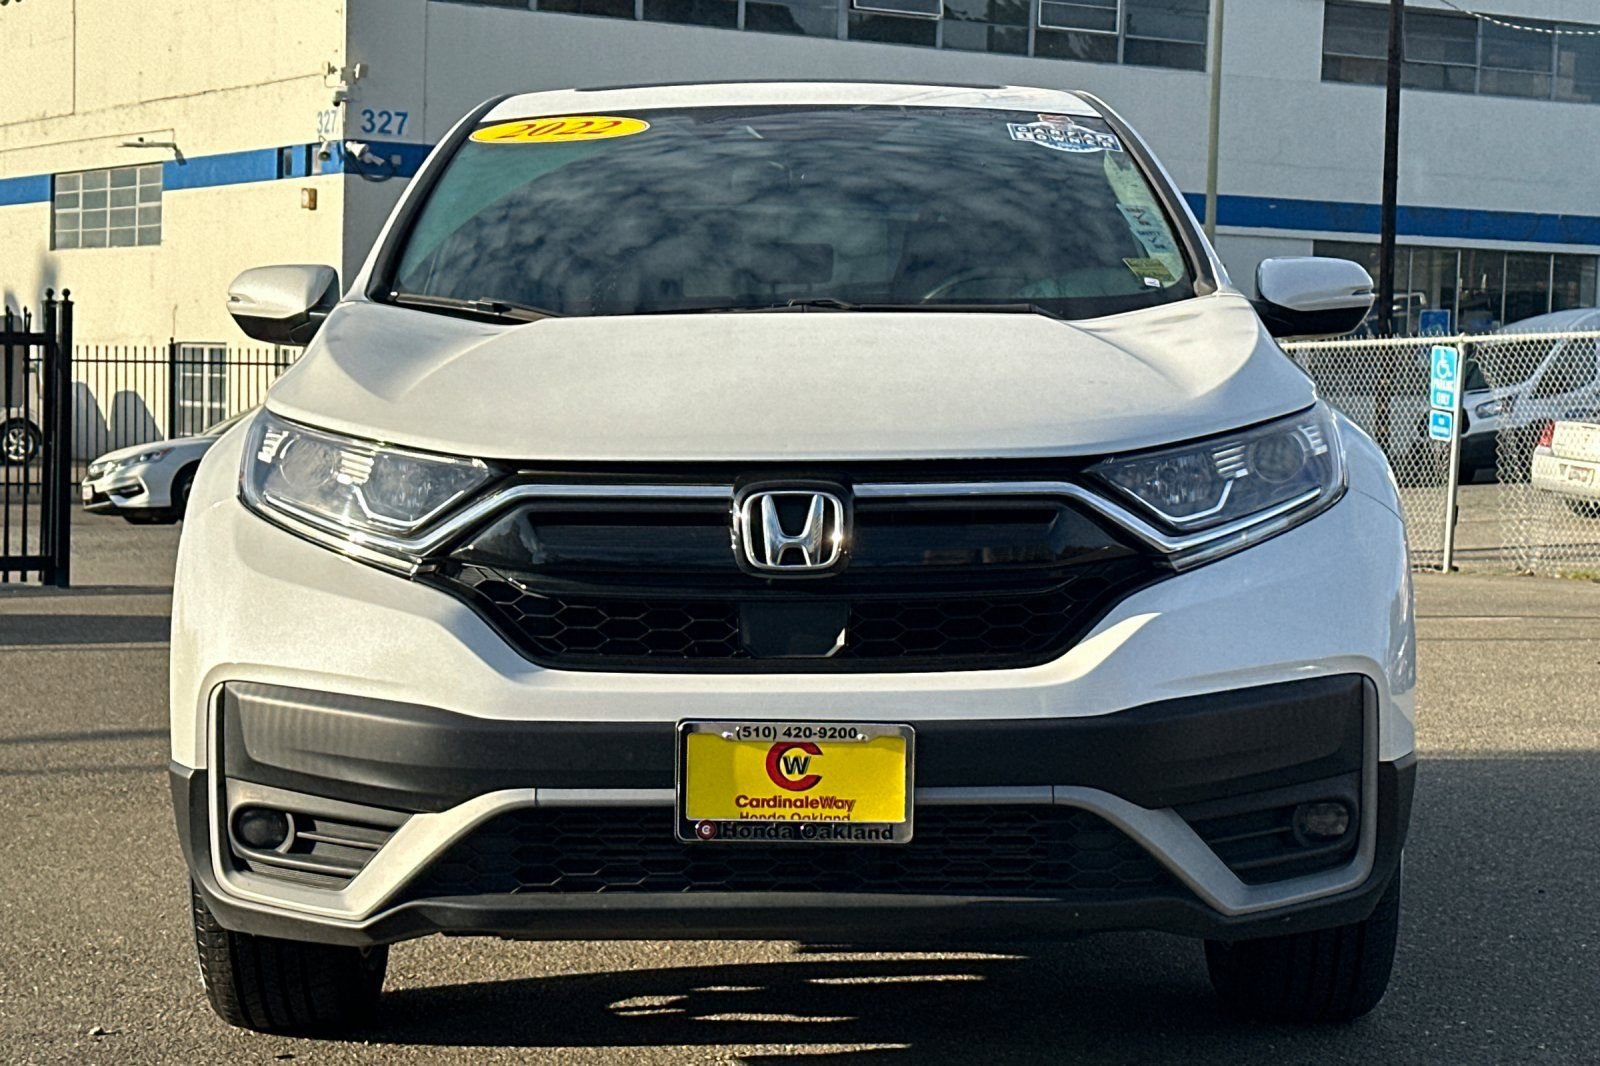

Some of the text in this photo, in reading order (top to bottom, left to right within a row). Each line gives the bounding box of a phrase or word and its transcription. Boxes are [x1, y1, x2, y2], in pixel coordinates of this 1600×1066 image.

[317, 109, 336, 134] 327
[361, 104, 408, 135] 327
[496, 120, 622, 139] 2022
[736, 726, 858, 741] (510) 420-9200
[735, 795, 856, 812] CardinaleWay
[722, 822, 894, 841] Honda Oakland
